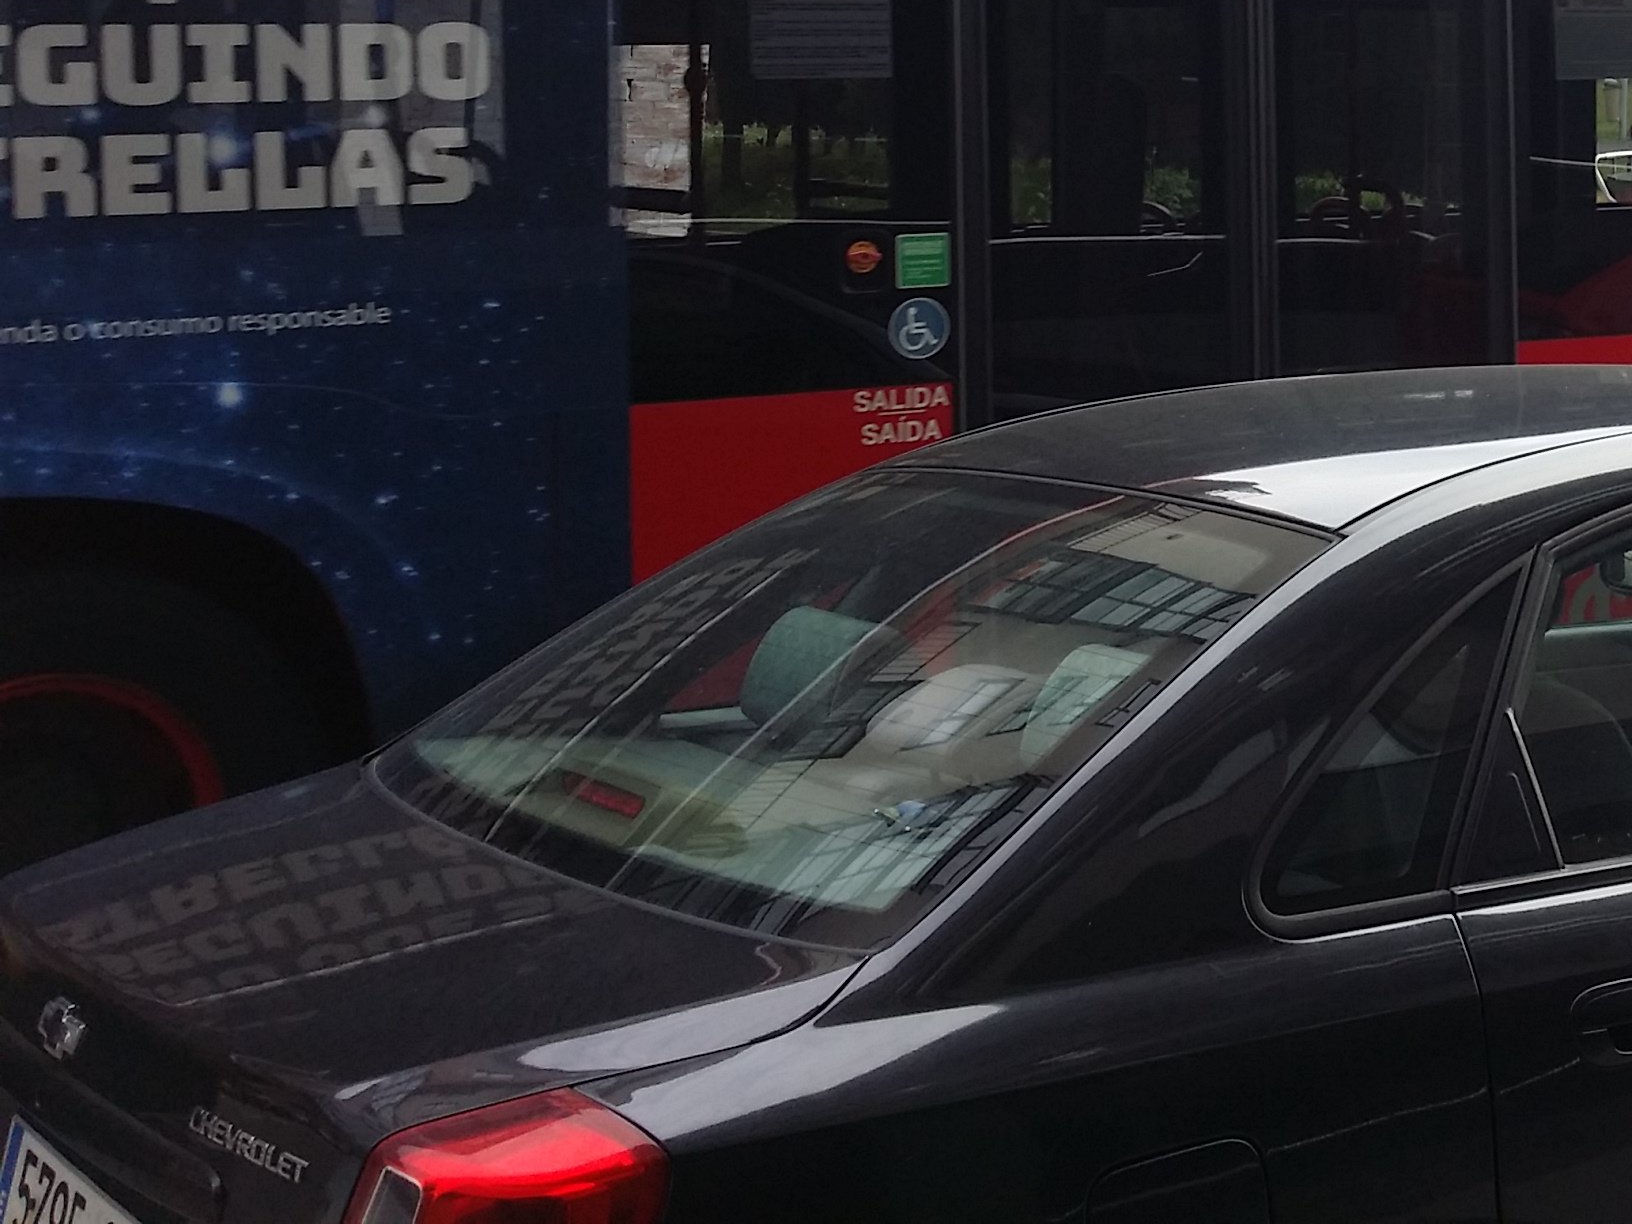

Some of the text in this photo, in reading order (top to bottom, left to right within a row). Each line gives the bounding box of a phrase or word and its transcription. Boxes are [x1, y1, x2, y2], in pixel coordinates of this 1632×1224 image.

[88, 312, 223, 340] consumo
[227, 301, 392, 336] responsable
[853, 385, 950, 413] SALIDA
[860, 416, 942, 446] SAÍDA
[188, 1105, 311, 1184] CHEVROLET
